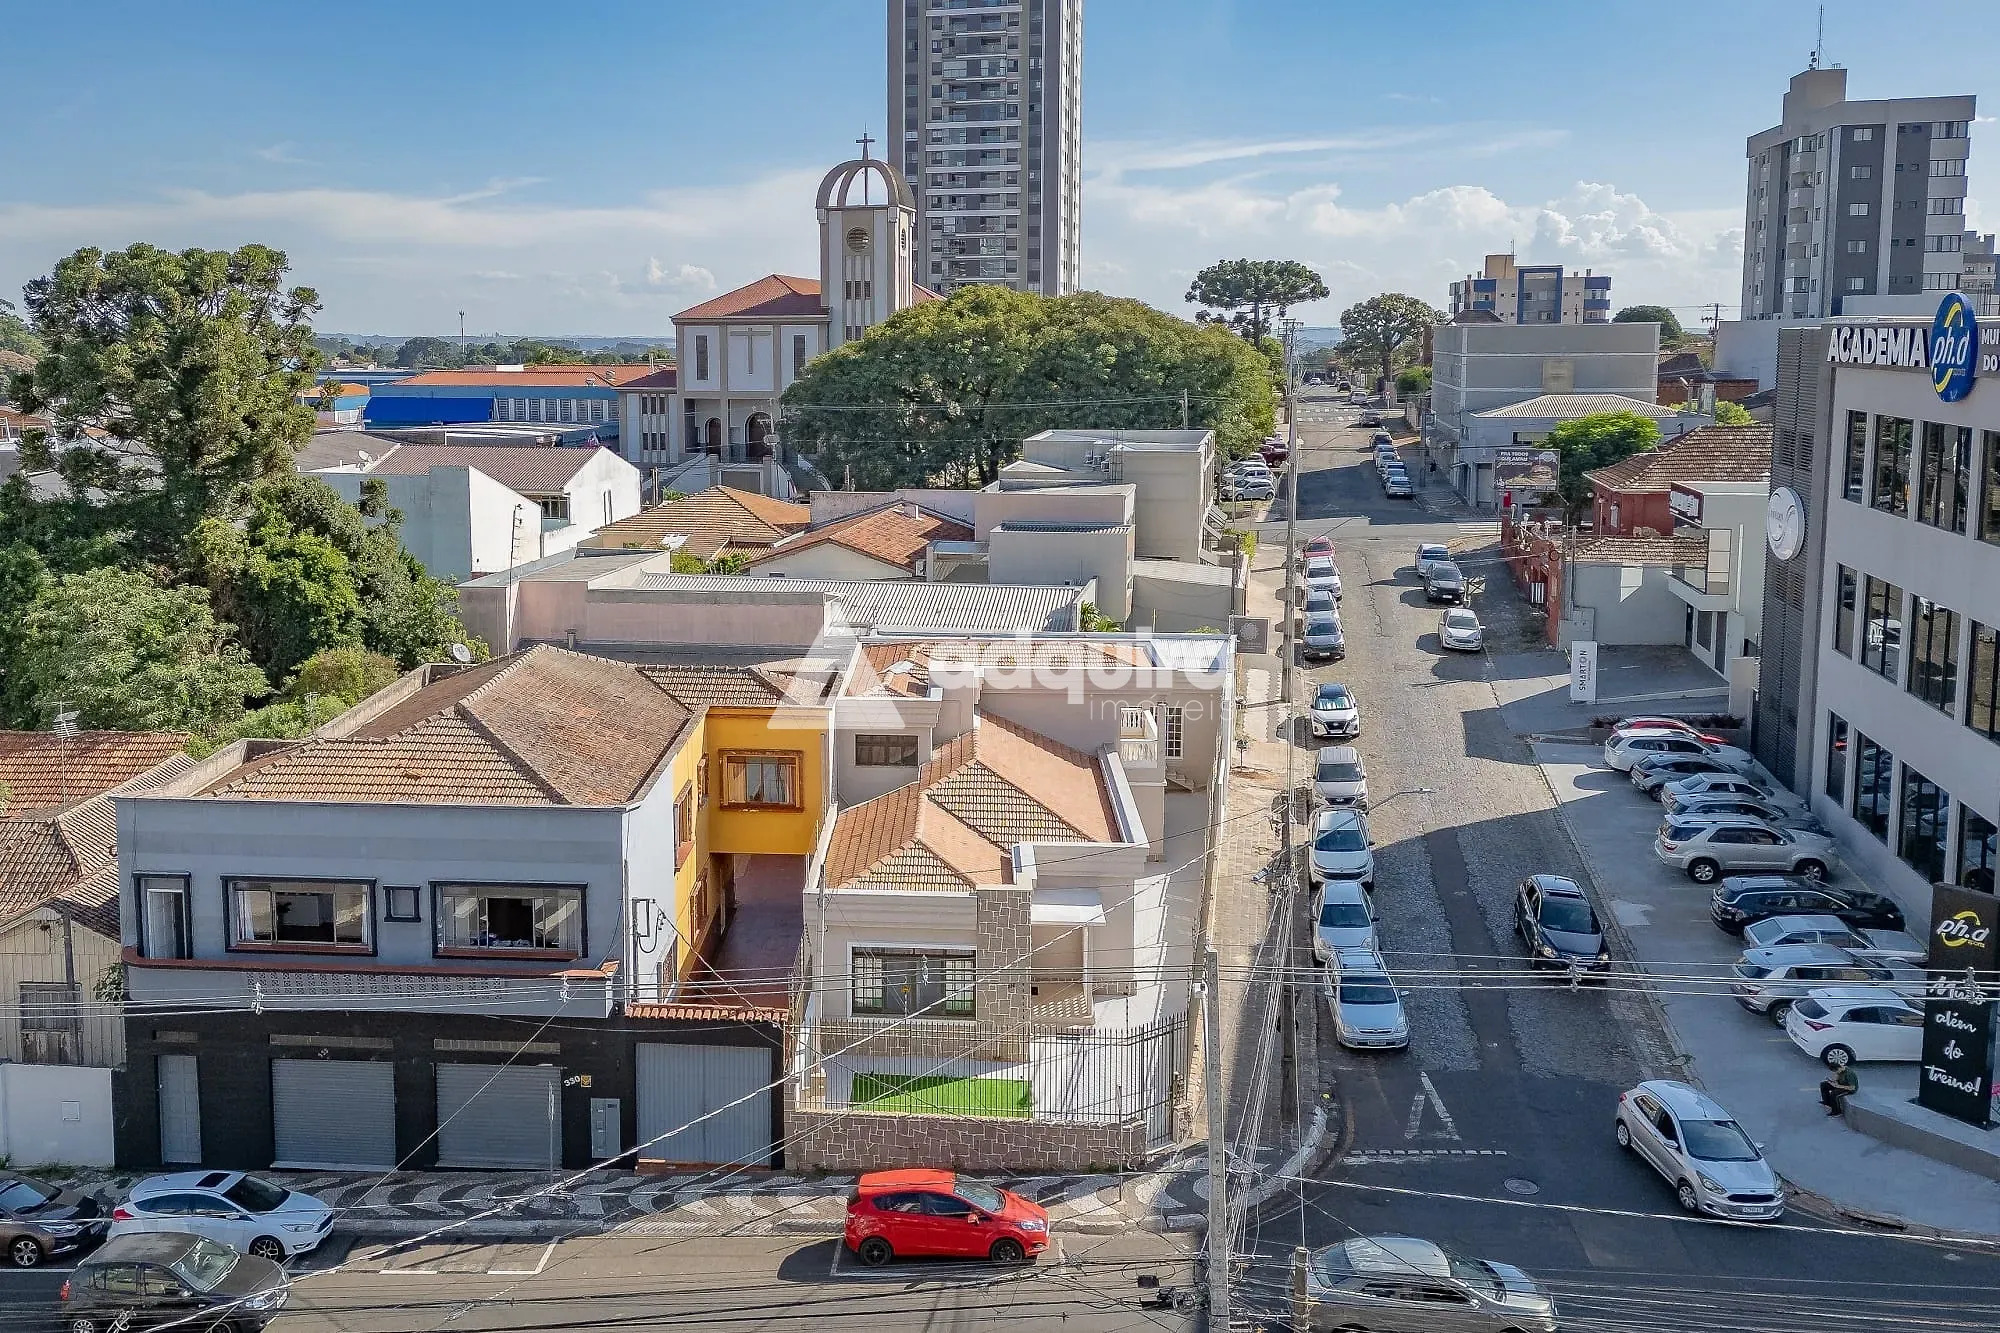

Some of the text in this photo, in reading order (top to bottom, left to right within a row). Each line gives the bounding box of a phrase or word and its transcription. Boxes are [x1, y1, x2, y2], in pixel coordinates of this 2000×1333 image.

[1827, 326, 1926, 368] ACADEMIA
[1981, 328, 2000, 345] MUI
[1931, 327, 1970, 371] ph.d
[1579, 650, 1588, 691] SMARTON
[1936, 919, 1990, 942] ph.d
[1935, 1010, 1977, 1033] além
[1944, 1040, 1965, 1060] do
